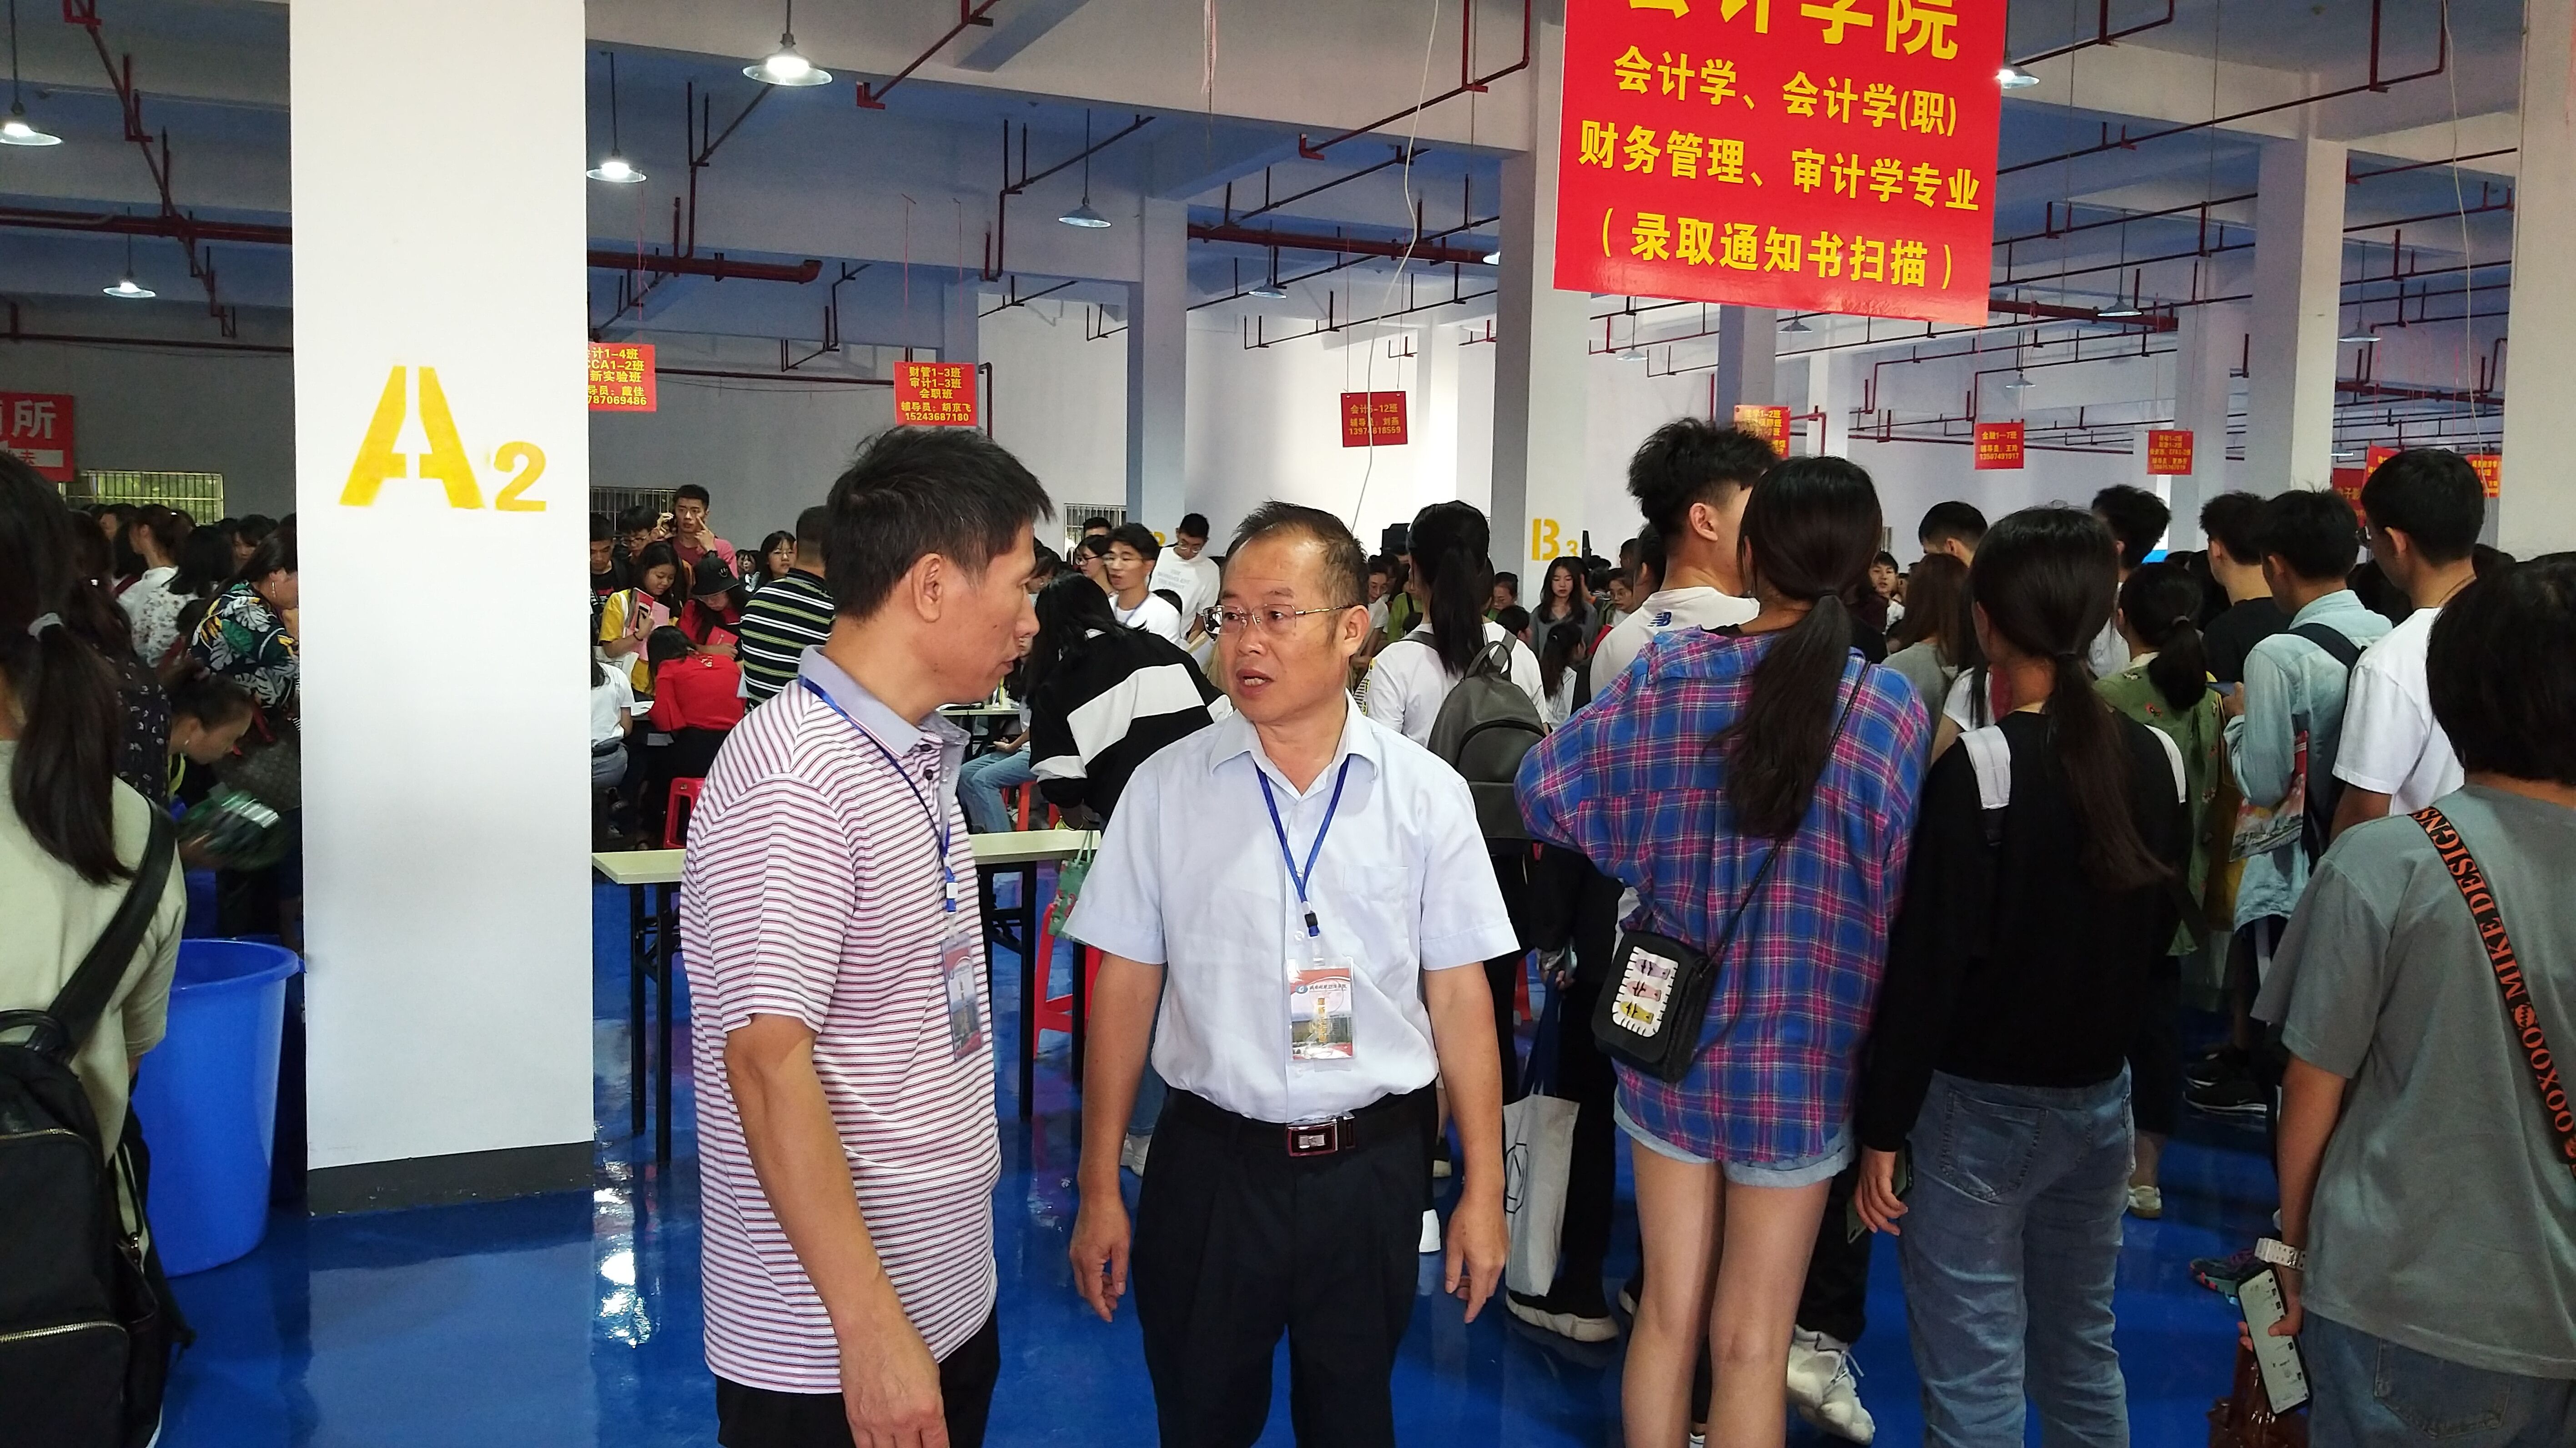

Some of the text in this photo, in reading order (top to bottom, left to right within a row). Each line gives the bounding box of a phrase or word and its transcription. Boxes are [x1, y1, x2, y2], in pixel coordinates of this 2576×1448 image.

[1630, 0, 1958, 60] 学院
[1614, 45, 1956, 137] 会计学、会计学(职)
[1579, 120, 1980, 212] 财务管理、审计学专业
[590, 370, 642, 383] 新实验班
[909, 366, 961, 378] 财管1-3班
[910, 378, 962, 388] 审计1-3班
[919, 388, 953, 399] 会职班
[0, 399, 56, 439] 所
[339, 365, 546, 511] A2
[905, 412, 969, 422] 15243687180
[2414, 808, 2496, 915] DESIGNS
[2480, 917, 2527, 1001] MIKE
